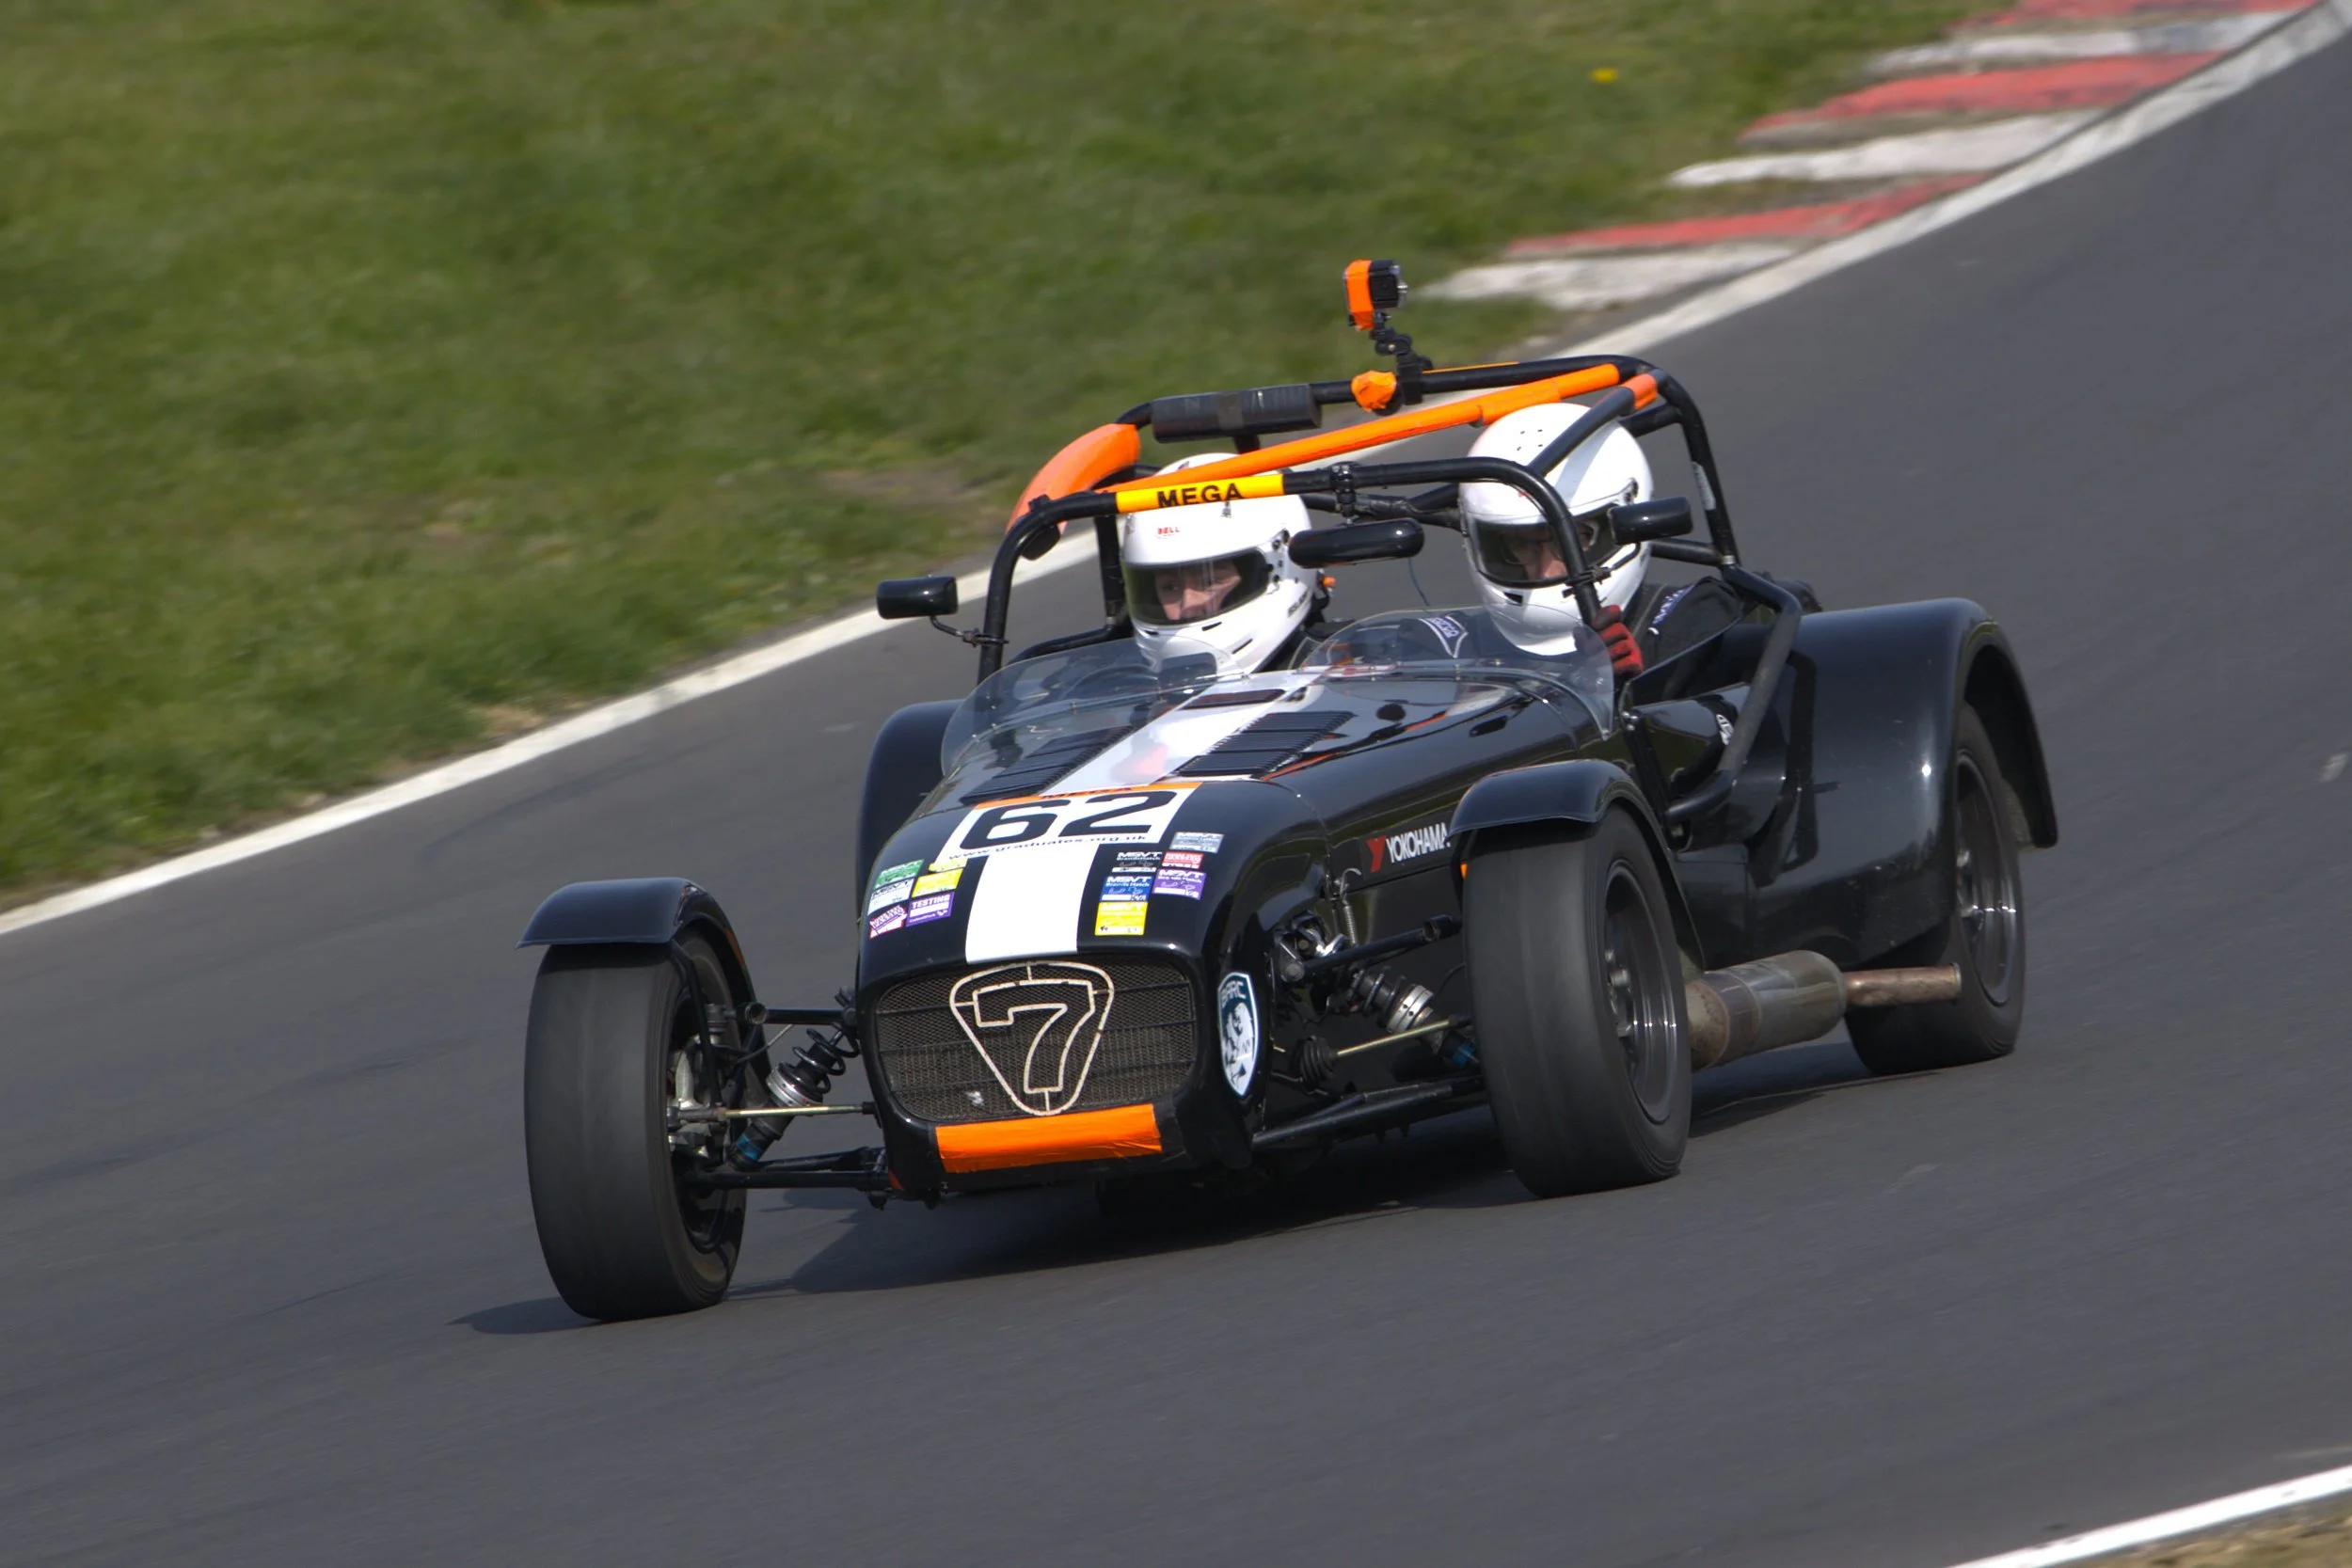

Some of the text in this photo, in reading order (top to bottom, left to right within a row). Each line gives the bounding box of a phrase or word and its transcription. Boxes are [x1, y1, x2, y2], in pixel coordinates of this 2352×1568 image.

[1157, 483, 1243, 509] MEGA
[1157, 527, 1180, 535] BELL
[960, 790, 1178, 849] 62
[1386, 822, 1451, 863] YOKOHAMA
[1158, 869, 1203, 879] MSVT
[912, 895, 951, 909] TESTING
[973, 978, 1095, 1094] 7
